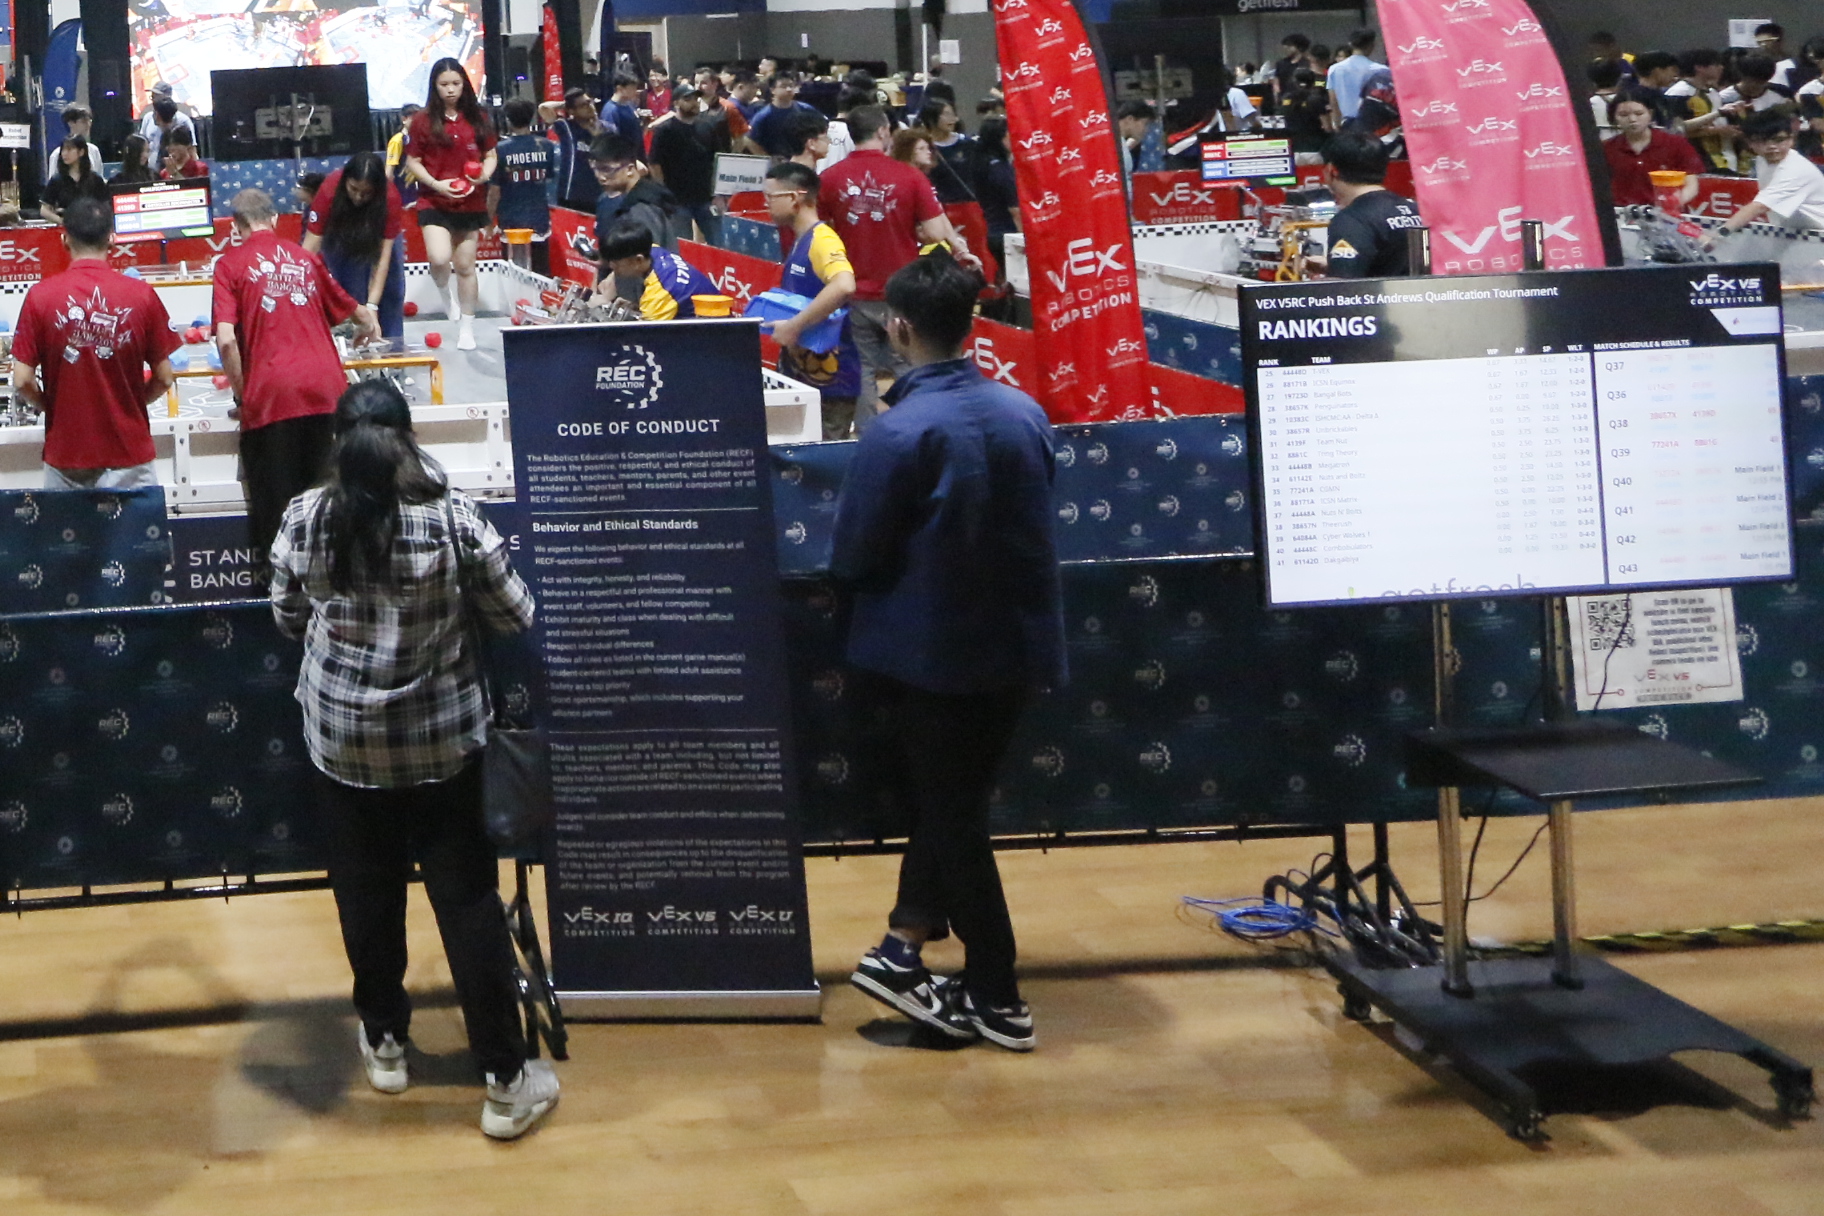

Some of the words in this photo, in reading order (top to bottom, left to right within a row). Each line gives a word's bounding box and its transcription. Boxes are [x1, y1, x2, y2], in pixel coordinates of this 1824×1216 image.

[1035, 18, 1062, 36] VEX
[1397, 36, 1444, 54] VEX
[1006, 62, 1040, 80] VEX
[1456, 59, 1504, 77] VEX
[1049, 86, 1071, 105] VEX
[1517, 84, 1563, 101] VEX
[1412, 100, 1458, 118] VEX
[1080, 110, 1107, 128] VEX
[1466, 117, 1517, 134] VEX
[1020, 130, 1052, 149] VEX
[1524, 141, 1573, 158] VEX
[506, 151, 547, 166] PHOENIX
[1422, 156, 1467, 174] VEX
[1090, 169, 1118, 188] VEX
[1149, 182, 1215, 206] VEX
[1151, 215, 1217, 224] COMPETITION
[1047, 238, 1126, 293] VEX
[708, 266, 752, 301] VEX
[1689, 274, 1737, 292] VEX
[1738, 278, 1761, 289] V5
[1256, 298, 1277, 310] VEX
[1277, 297, 1306, 308] V5RC
[1308, 295, 1334, 307] Push
[1336, 294, 1362, 306] Back
[1363, 294, 1375, 304] St
[1376, 292, 1423, 304] Andrews
[1425, 289, 1491, 304] Qualification
[1492, 286, 1558, 299] Tournament
[1690, 296, 1762, 305] COMPETITION
[1258, 316, 1376, 340] RANKINGS
[1106, 338, 1141, 356] VEX
[1619, 341, 1654, 349] SCHEDULE
[1661, 339, 1690, 347] RESULTS
[963, 337, 1020, 386] EX
[1311, 356, 1331, 364] TEAM
[1567, 344, 1583, 352] WLT
[596, 365, 646, 382] REC
[1605, 362, 1624, 372] Q37
[596, 382, 645, 390] FOUNDATION
[1607, 391, 1627, 400] Q36
[557, 423, 603, 436] CODE
[609, 422, 630, 434] OF
[636, 419, 720, 434] CONDUCT
[1609, 420, 1628, 429] Q38
[544, 454, 578, 462] Robotics
[580, 453, 619, 461] Education
[621, 452, 626, 460] &
[628, 451, 677, 460] Competition
[679, 450, 724, 458] Foundation
[726, 449, 753, 457] (RECF)
[1611, 448, 1630, 458] Q39
[584, 463, 616, 472] positive,
[619, 461, 662, 470] respectful,
[541, 474, 578, 482] students,
[580, 473, 616, 481] teachers,
[618, 472, 654, 480] mentors,
[656, 472, 689, 480] parents,
[1613, 477, 1632, 487] Q40
[1615, 506, 1633, 516] Q41
[532, 522, 580, 532] Behavior
[583, 521, 602, 531] and
[604, 520, 640, 530] Ethical
[643, 519, 698, 529] Standards
[1616, 535, 1636, 545] Q42
[189, 550, 215, 566] ST
[102, 568, 120, 577] REC
[1619, 564, 1638, 574] Q43
[95, 634, 117, 644] REC
[564, 906, 610, 923] VEX
[647, 905, 692, 922] VEX
[695, 911, 716, 921] V5
[730, 905, 775, 922] VEX
[778, 911, 793, 921] U
[730, 927, 796, 935] COMPETITION
